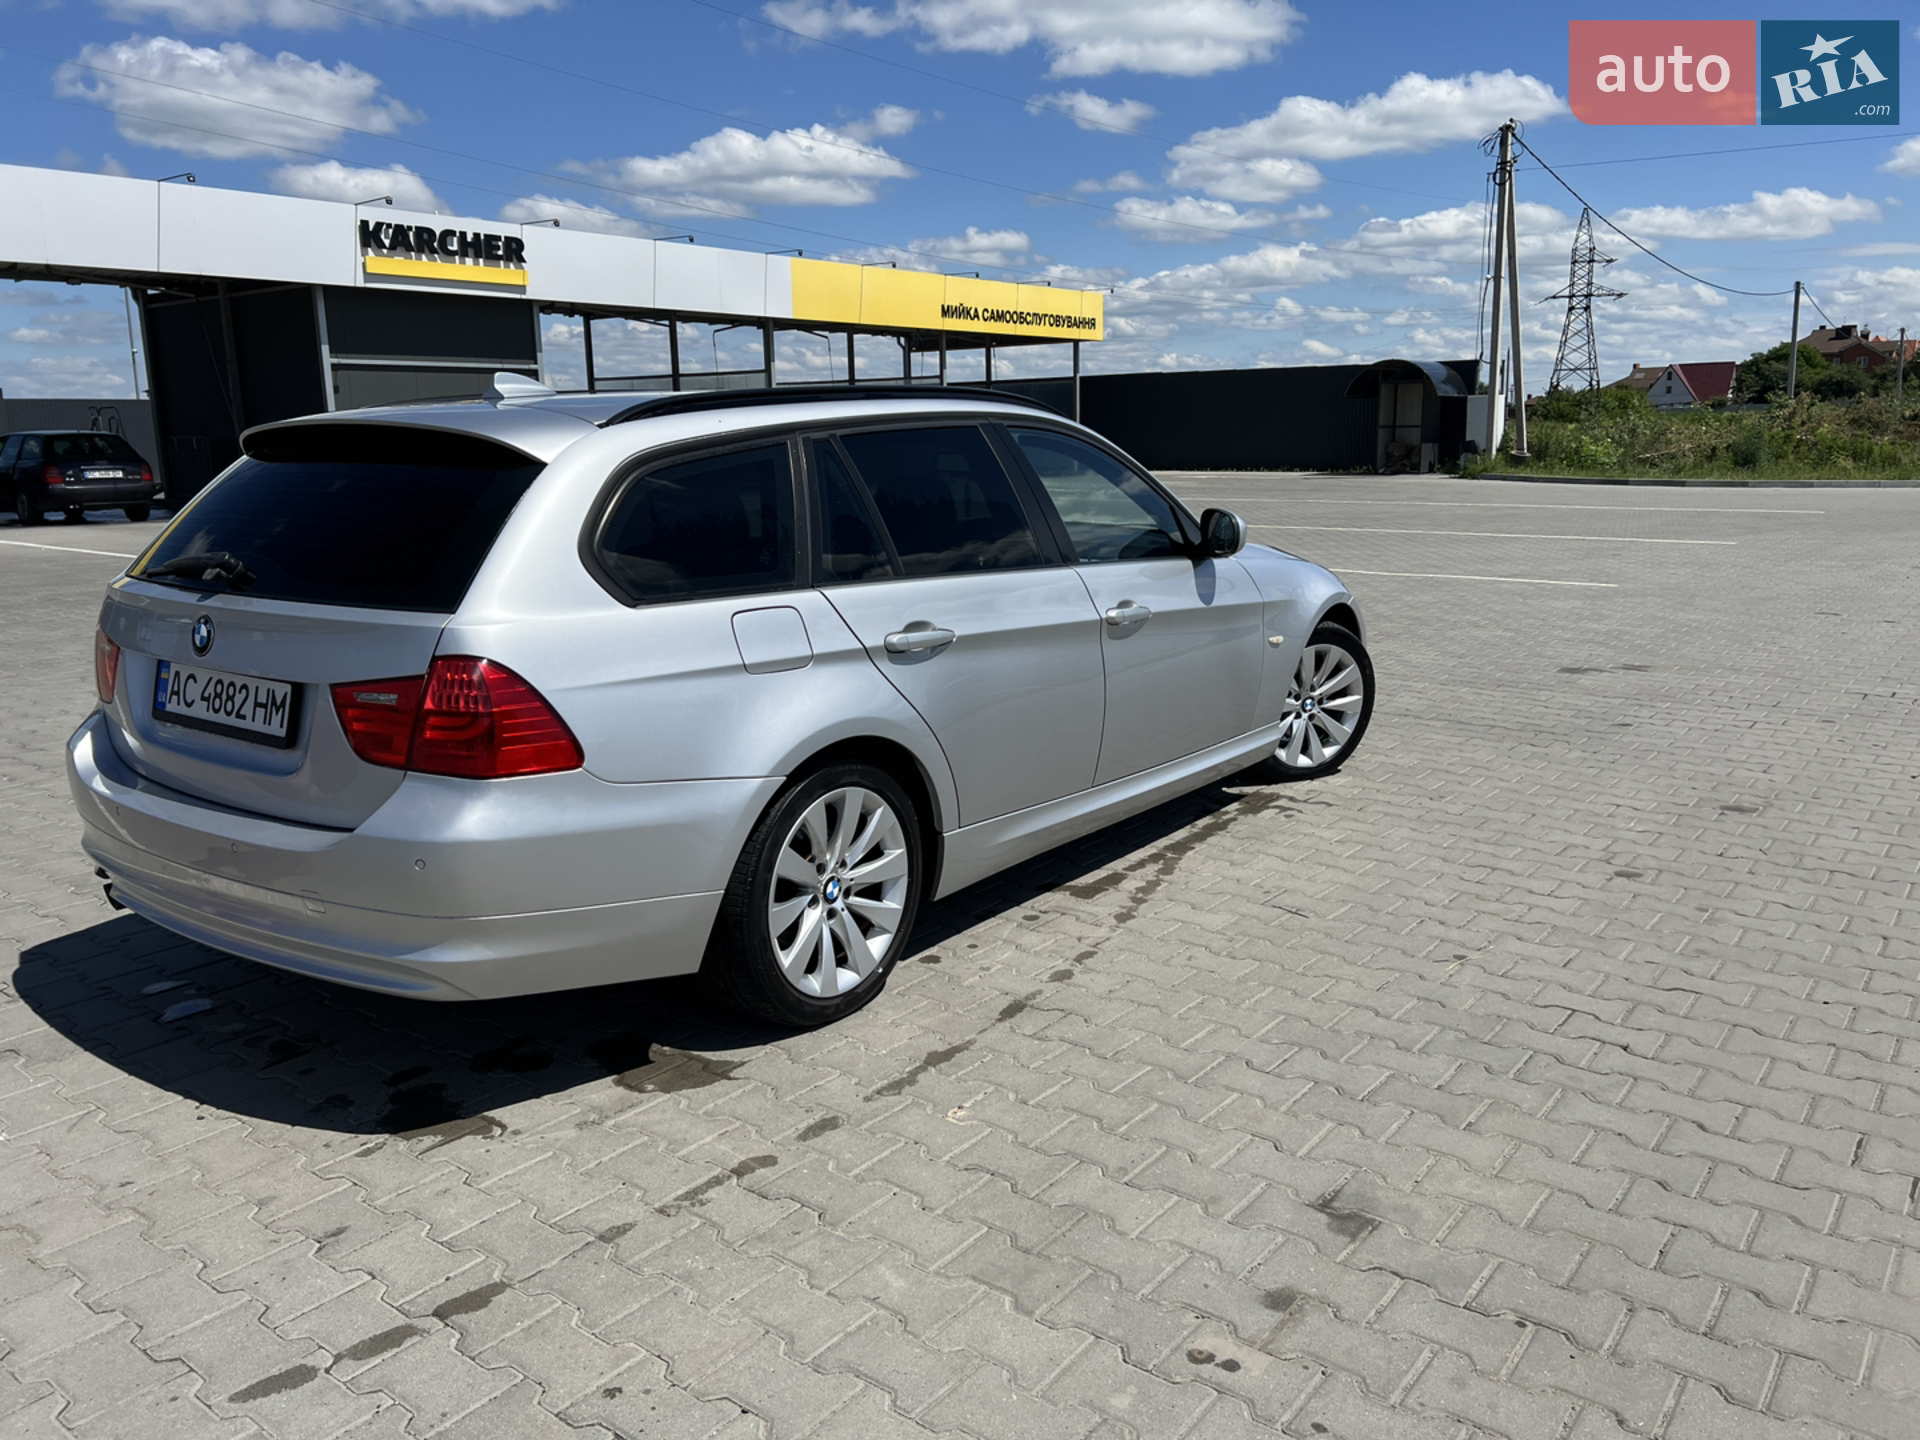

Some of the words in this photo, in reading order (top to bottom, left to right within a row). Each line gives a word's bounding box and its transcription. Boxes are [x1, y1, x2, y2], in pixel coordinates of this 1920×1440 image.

[359, 219, 527, 263] KÄRCHER
[941, 303, 980, 321] МИЙКА
[982, 308, 1096, 330] САМООБСЛУГОВУВАННЯ
[168, 670, 198, 708] AC
[200, 676, 249, 720] 4882
[252, 685, 288, 729] HM
